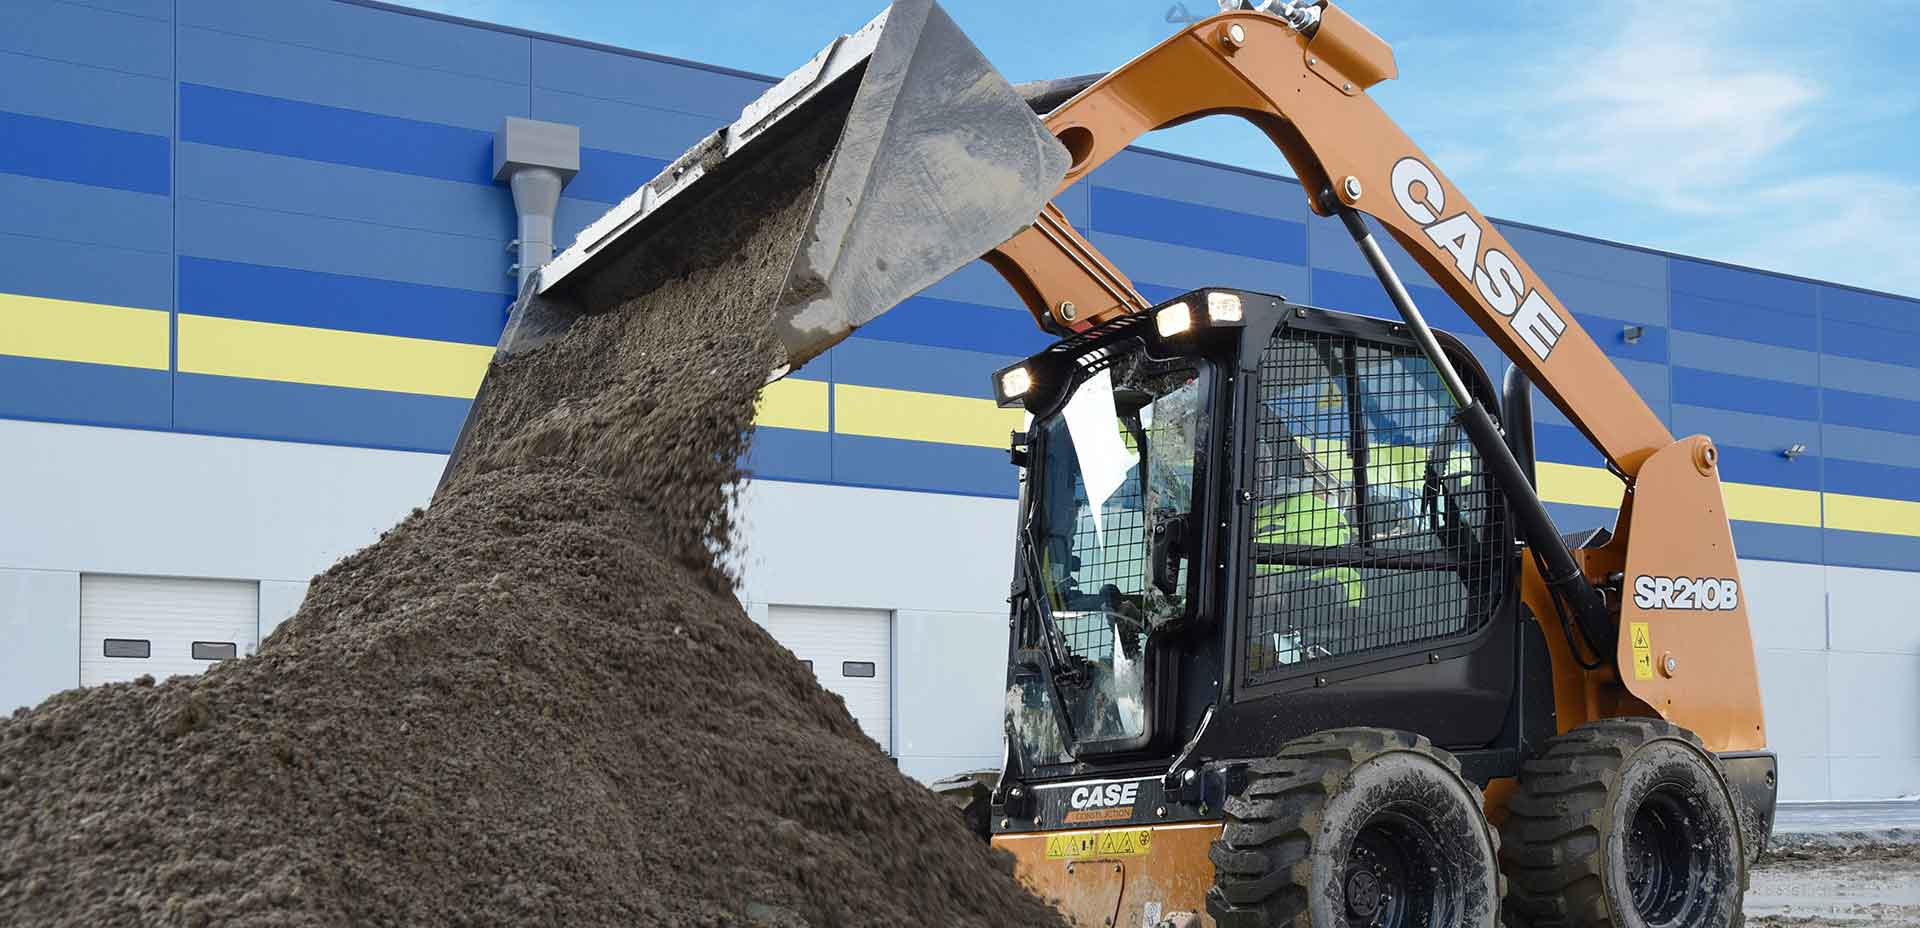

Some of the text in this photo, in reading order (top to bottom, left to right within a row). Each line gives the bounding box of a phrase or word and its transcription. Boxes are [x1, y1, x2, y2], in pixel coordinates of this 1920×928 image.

[1390, 156, 1568, 362] CASE
[1633, 575, 1738, 611] SR210B
[1071, 782, 1139, 809] CASE
